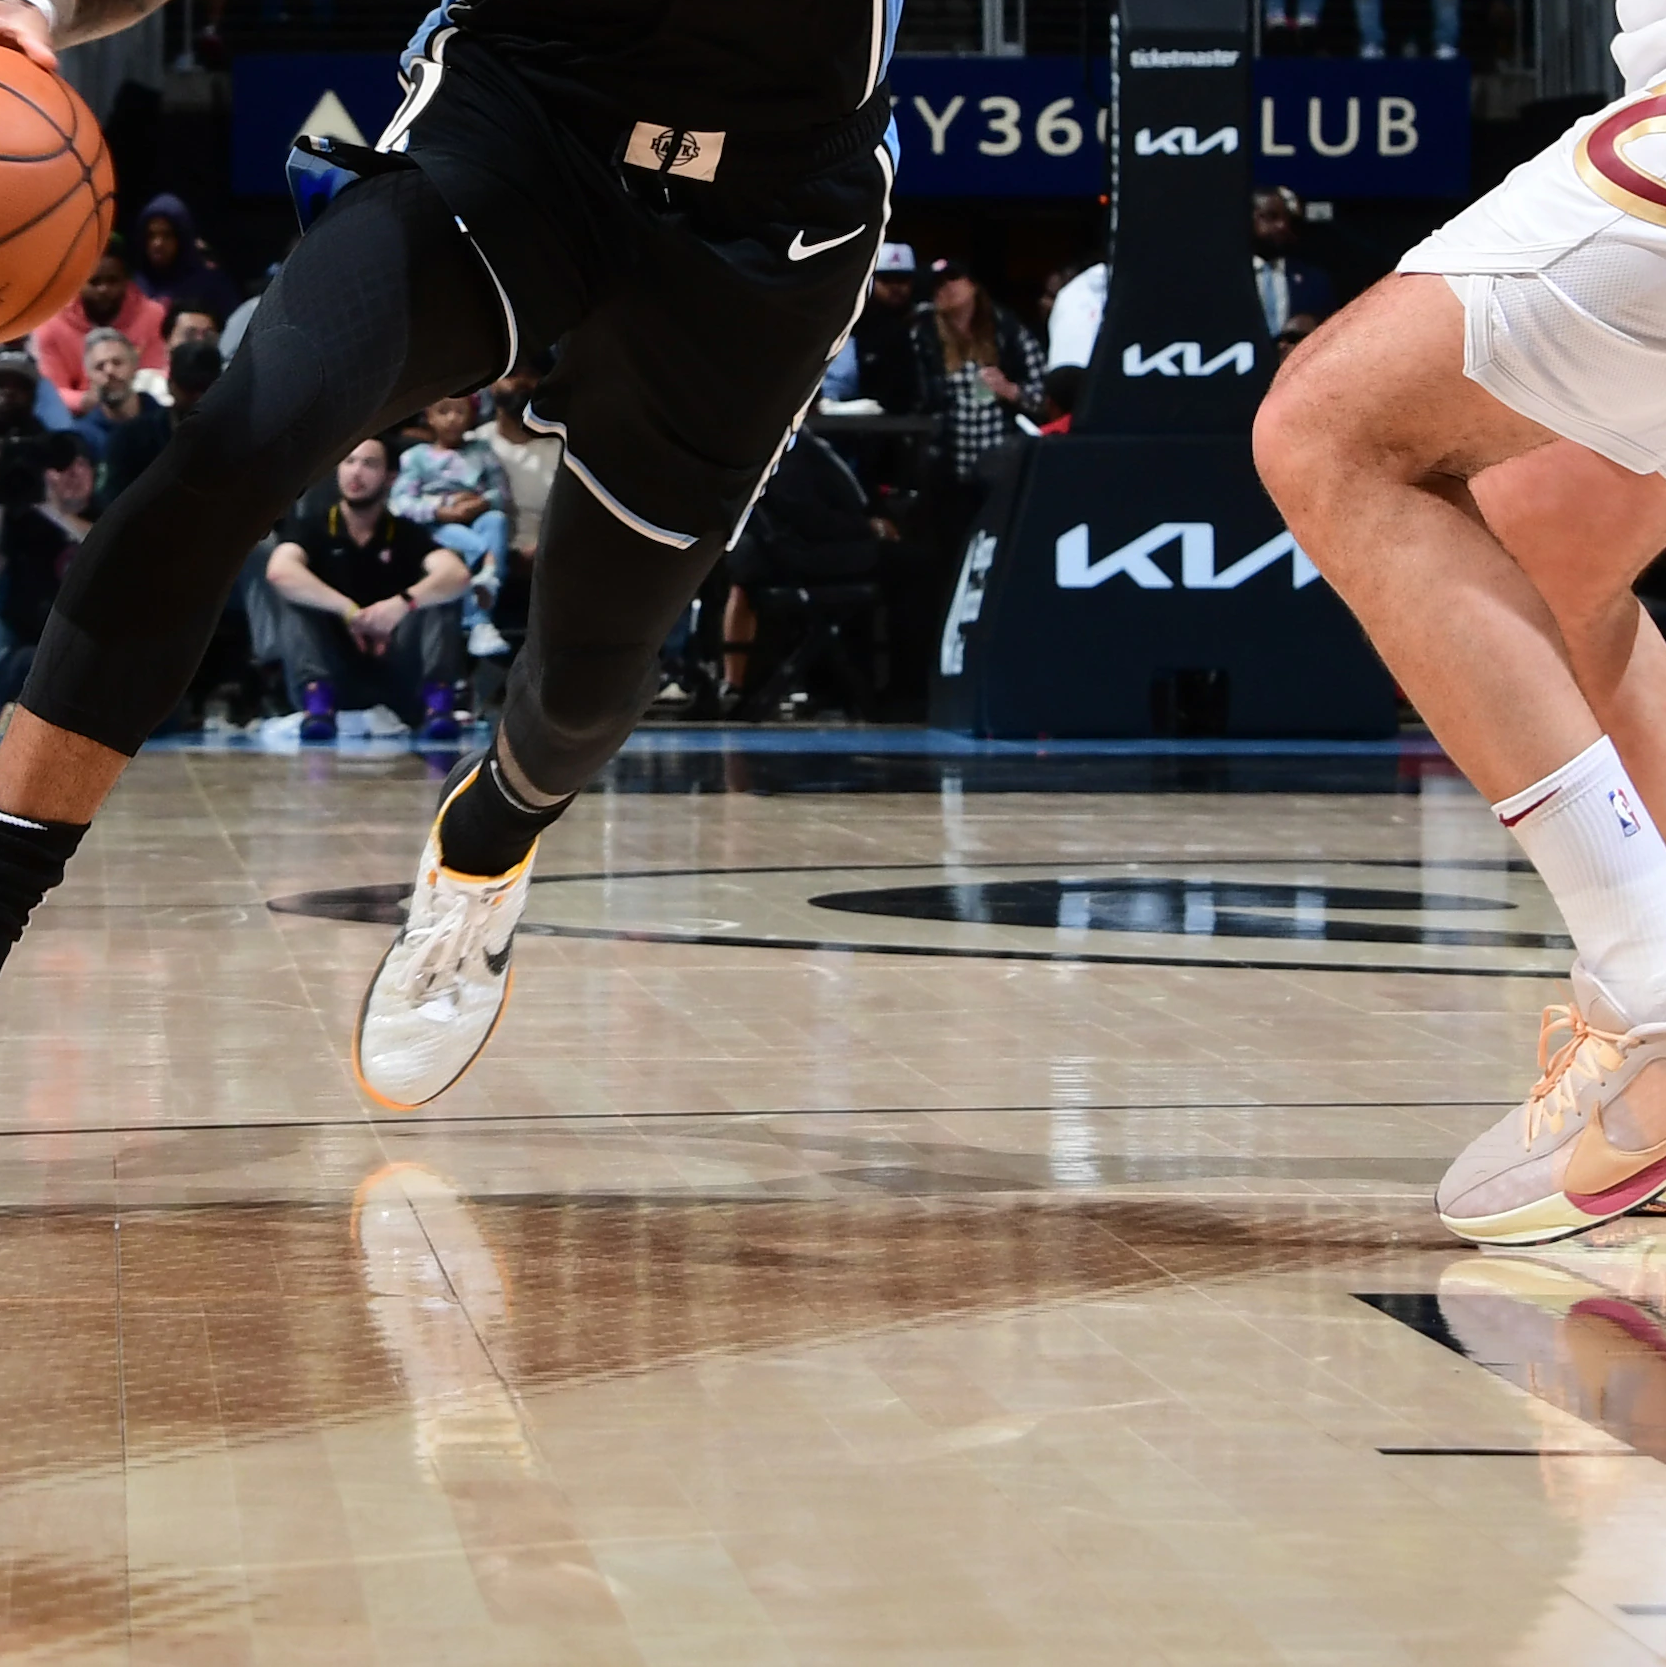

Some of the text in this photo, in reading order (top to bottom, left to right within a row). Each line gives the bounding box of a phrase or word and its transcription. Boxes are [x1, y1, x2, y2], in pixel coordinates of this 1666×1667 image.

[1129, 46, 1241, 69] ticketmaster
[889, 94, 1419, 158] Y36 LUB
[649, 136, 701, 159] HAKS
